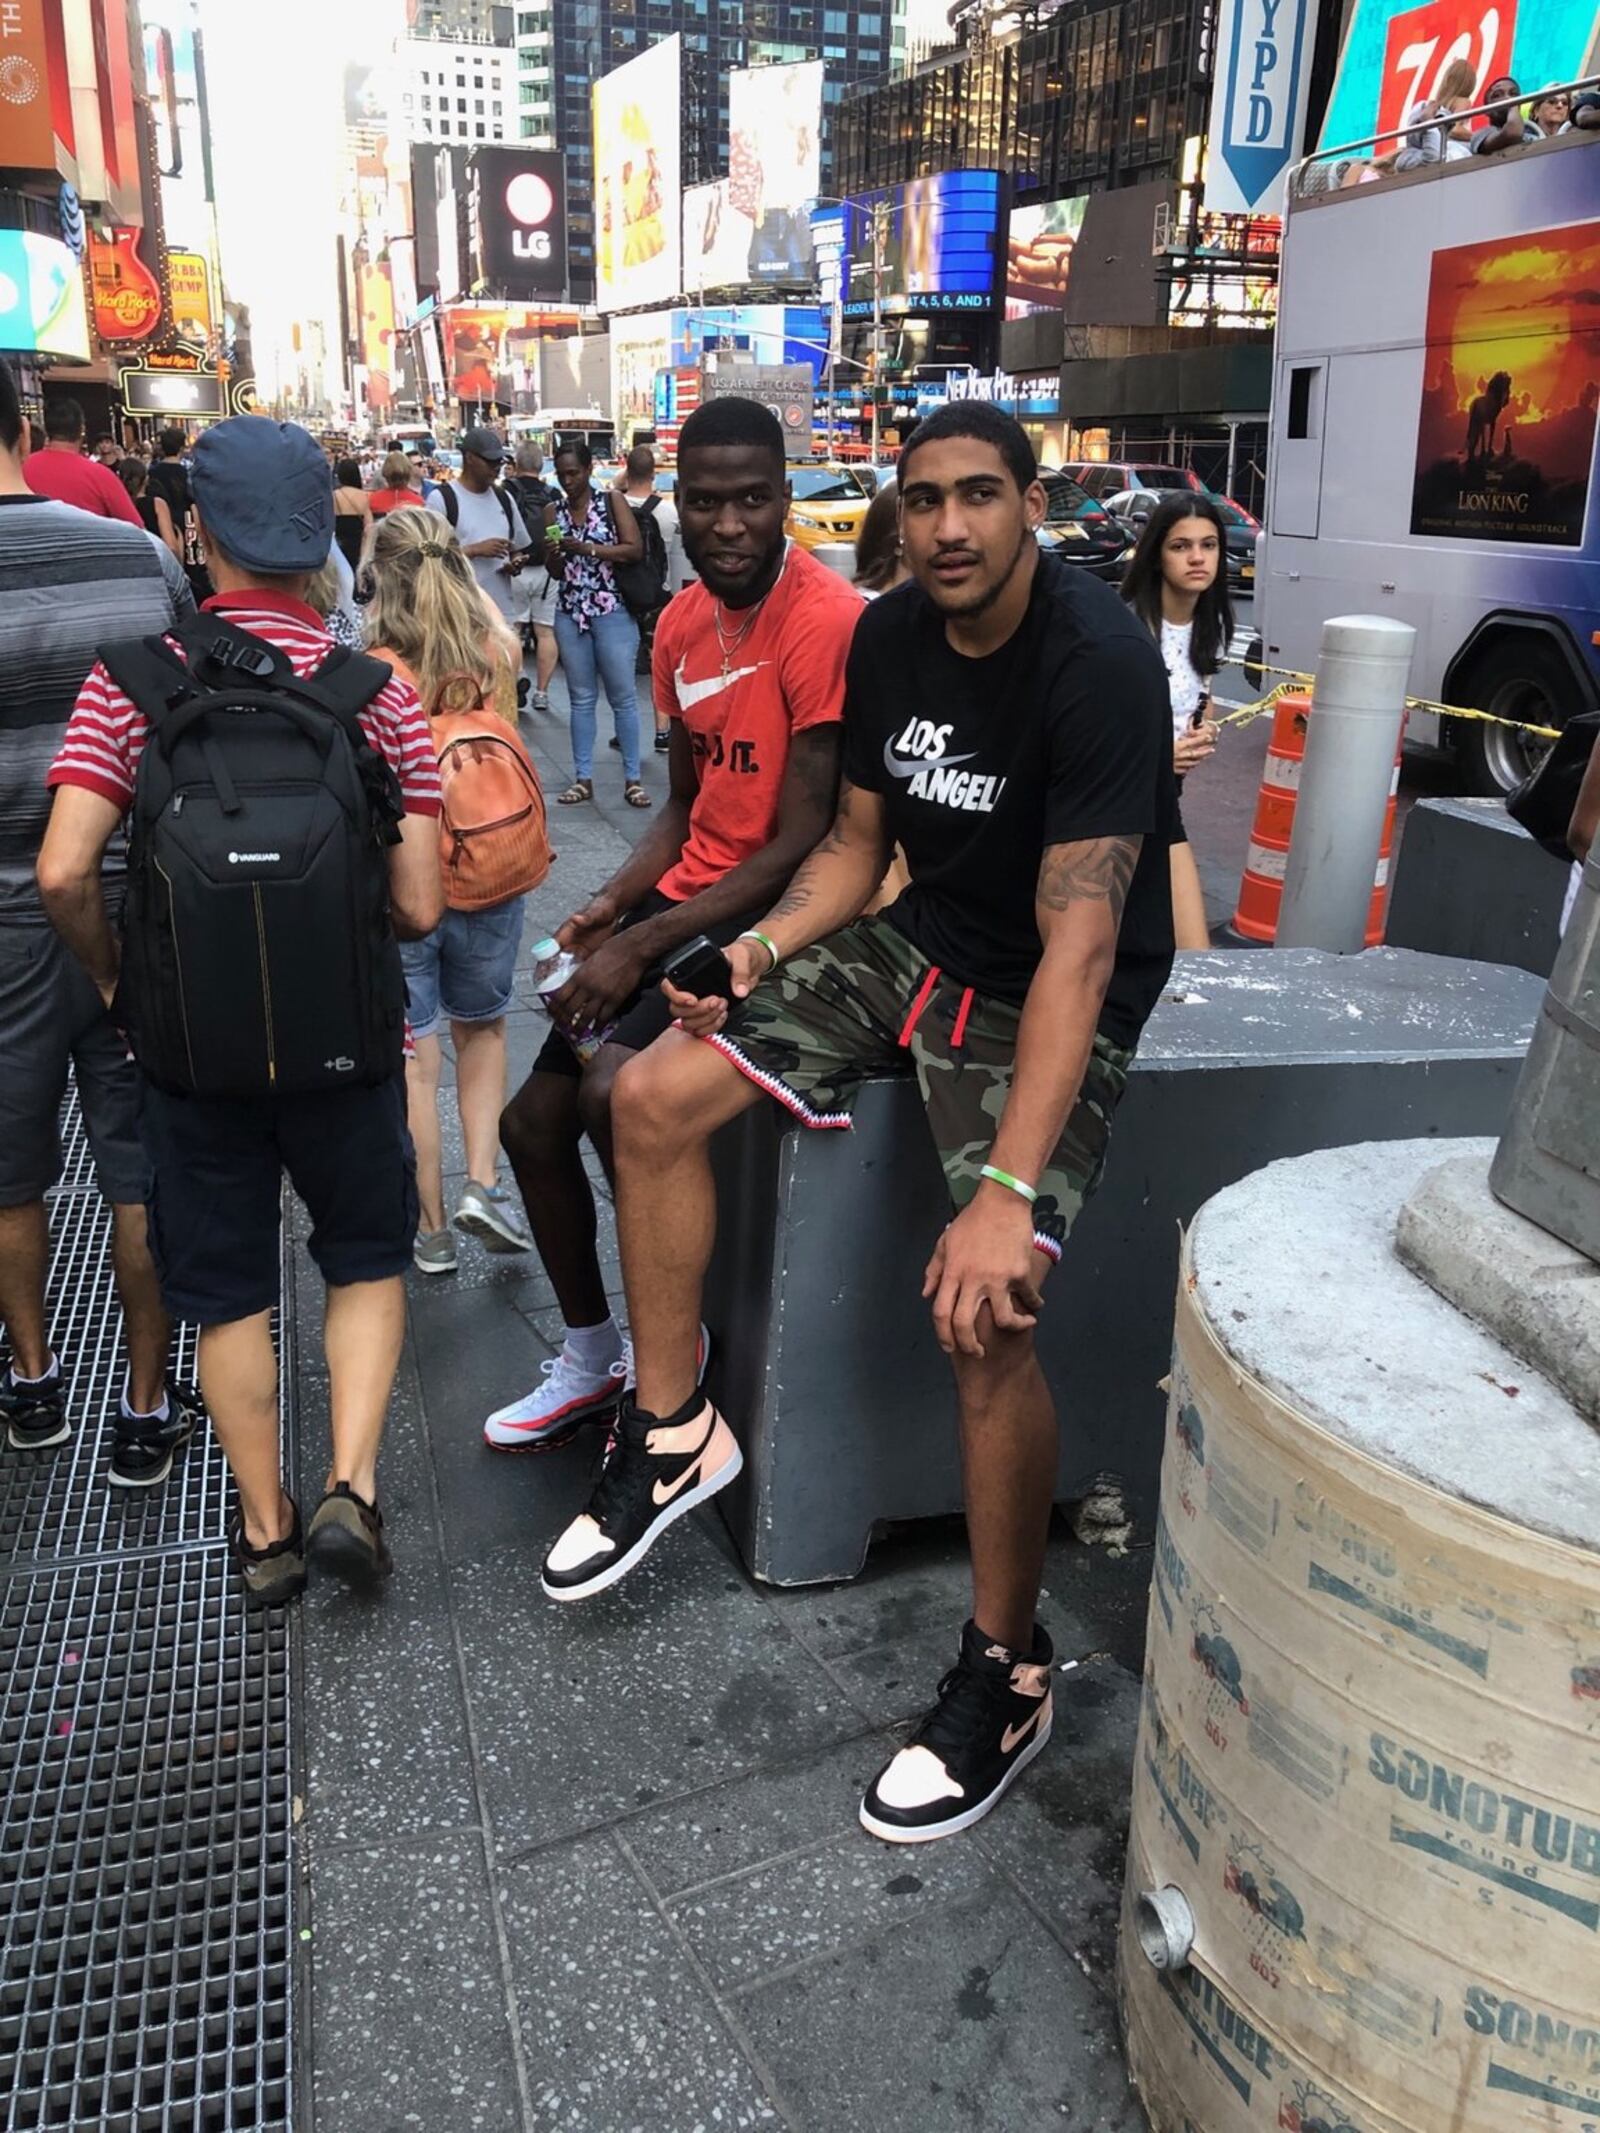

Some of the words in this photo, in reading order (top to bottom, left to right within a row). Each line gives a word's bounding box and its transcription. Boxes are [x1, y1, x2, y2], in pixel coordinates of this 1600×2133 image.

[512, 230, 551, 259] LG
[919, 295, 929, 308] 4,
[930, 295, 940, 308] 5,
[942, 294, 953, 308] 6,
[955, 294, 983, 307] AND
[985, 295, 992, 307] 1
[1458, 491, 1489, 511] LION
[1490, 493, 1529, 514] KING
[894, 715, 955, 761] LOS
[906, 767, 1008, 813] ANGEL
[1444, 1829, 1539, 1880] round
